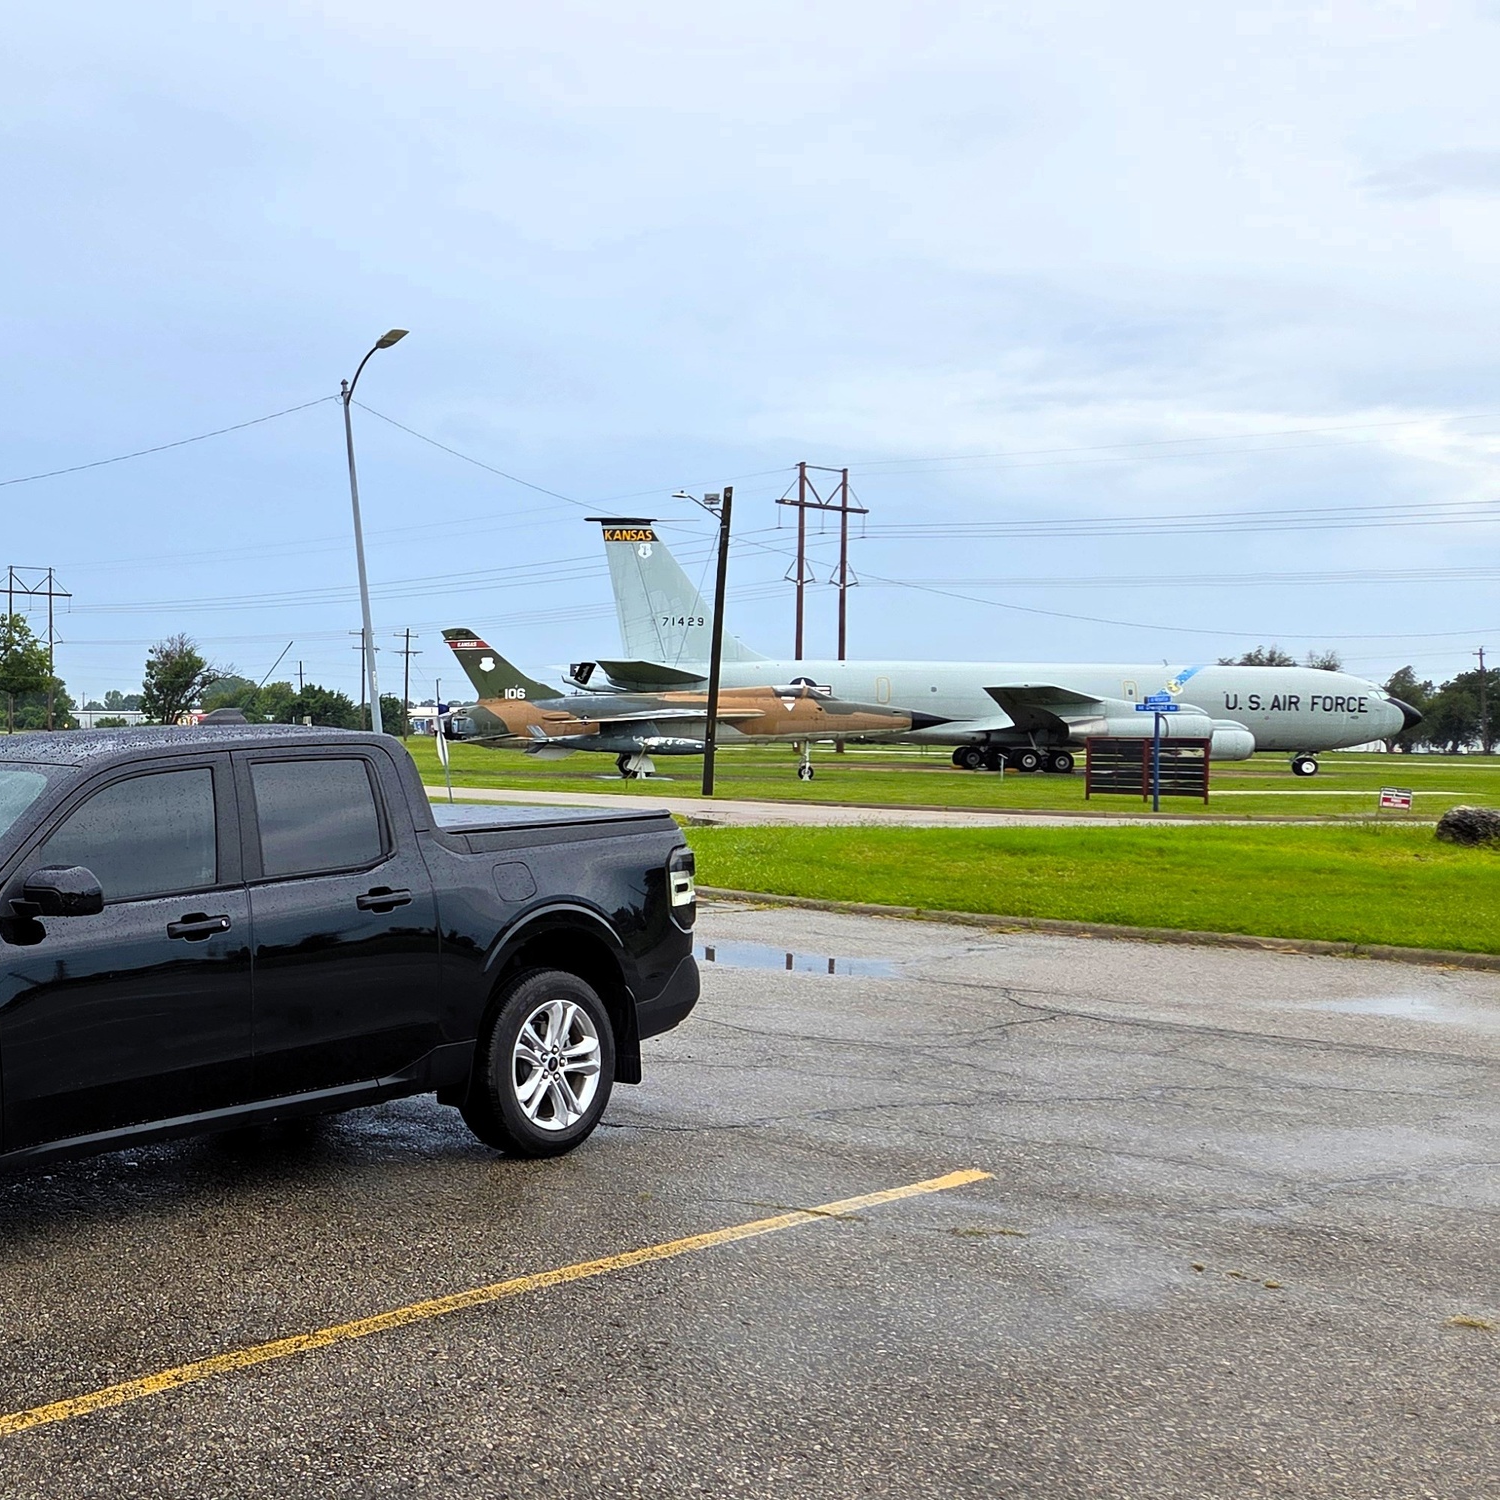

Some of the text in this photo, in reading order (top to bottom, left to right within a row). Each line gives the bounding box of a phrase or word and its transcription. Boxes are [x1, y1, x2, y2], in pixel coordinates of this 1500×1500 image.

[604, 529, 653, 541] KANSAS
[662, 616, 704, 627] 71429
[504, 687, 526, 700] 106
[1269, 694, 1300, 711] AIR
[1310, 695, 1369, 713] FORCE
